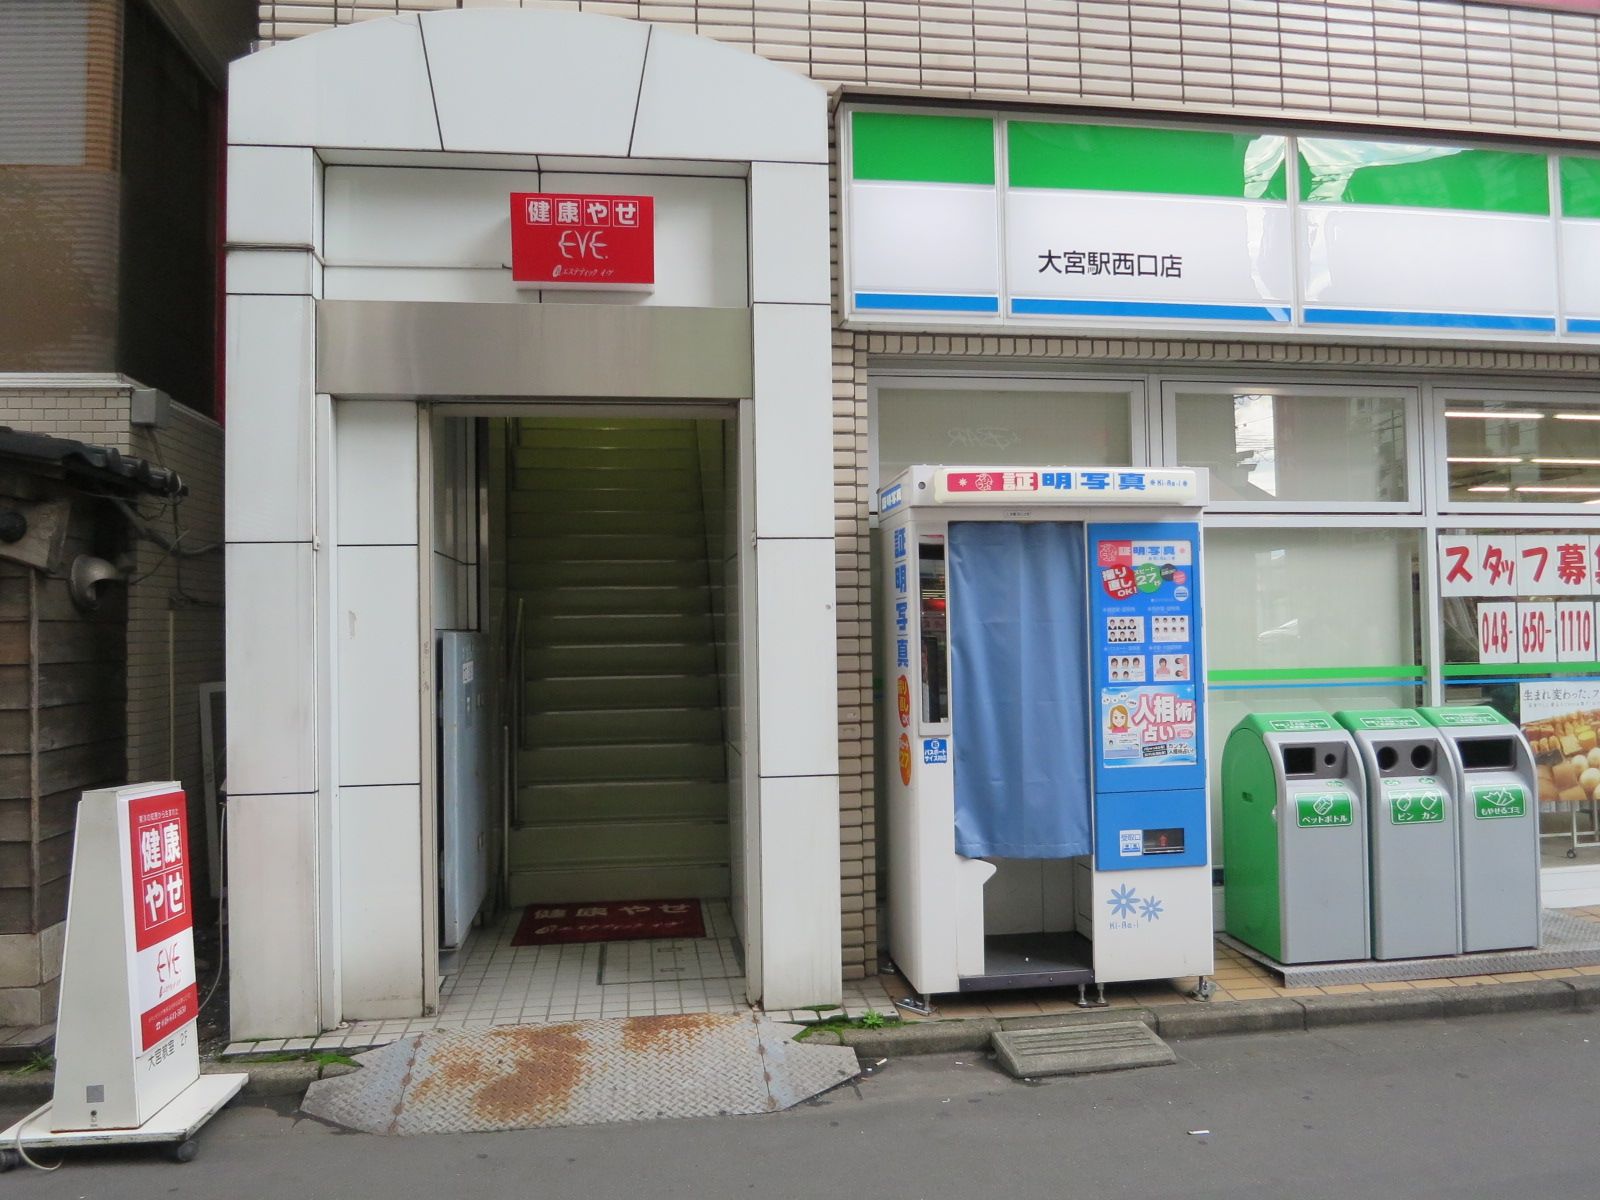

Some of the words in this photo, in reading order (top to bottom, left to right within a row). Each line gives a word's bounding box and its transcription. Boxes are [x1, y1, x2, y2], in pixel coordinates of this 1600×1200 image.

[527, 200, 638, 226] 健康やせ
[1038, 249, 1182, 279] 大宮駅西口店
[1001, 472, 1146, 491] 証明写真
[894, 527, 909, 668] 証明写真
[1133, 694, 1193, 724] 人相術
[1302, 815, 1348, 824] ペットボトル
[141, 822, 181, 872] 健康
[145, 872, 183, 922] やせ
